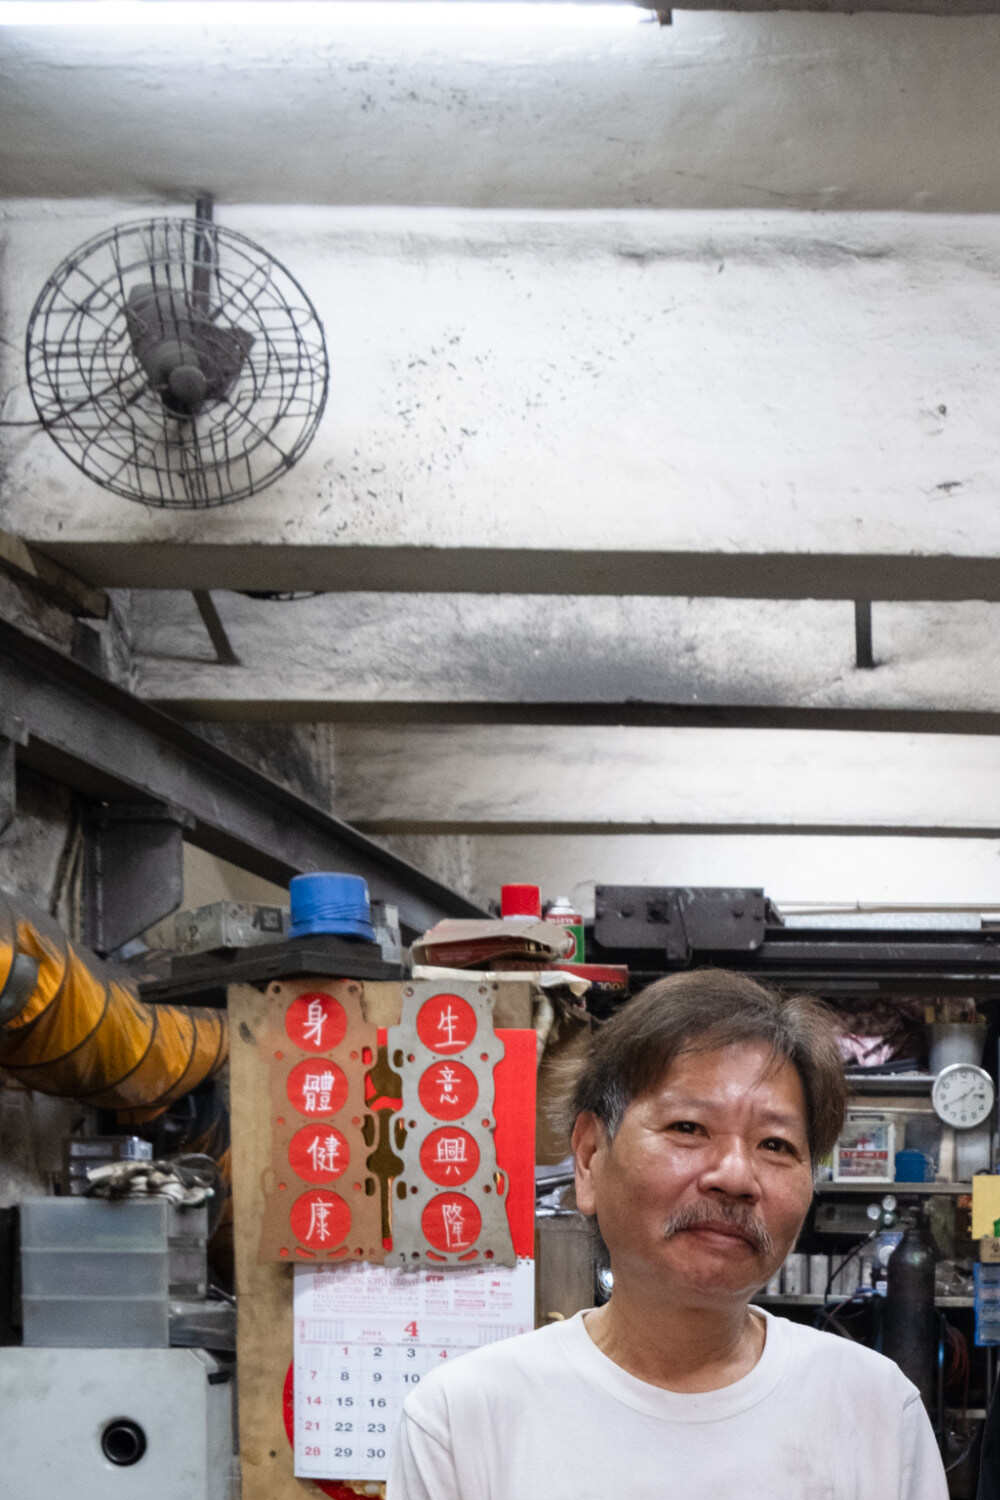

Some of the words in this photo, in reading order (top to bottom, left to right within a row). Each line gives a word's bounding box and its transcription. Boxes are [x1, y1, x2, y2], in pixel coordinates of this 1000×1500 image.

[303, 1000, 340, 1241] 身體健康
[434, 1005, 470, 1248] 生意興隆
[403, 1321, 419, 1337] 4
[343, 1347, 349, 1355] 1
[373, 1348, 382, 1356] 2
[407, 1349, 416, 1358] 3
[439, 1350, 448, 1359] 4
[310, 1371, 317, 1380] 7
[340, 1372, 349, 1381] 8
[373, 1373, 382, 1382] 9
[403, 1374, 420, 1383] 10
[306, 1396, 321, 1405] 14
[337, 1397, 353, 1407] 15
[369, 1398, 386, 1408] 16
[305, 1421, 320, 1430] 21
[335, 1422, 353, 1432] 22
[367, 1423, 386, 1433] 23
[305, 1447, 320, 1456] 28
[334, 1448, 352, 1457] 29
[367, 1449, 385, 1458] 30
